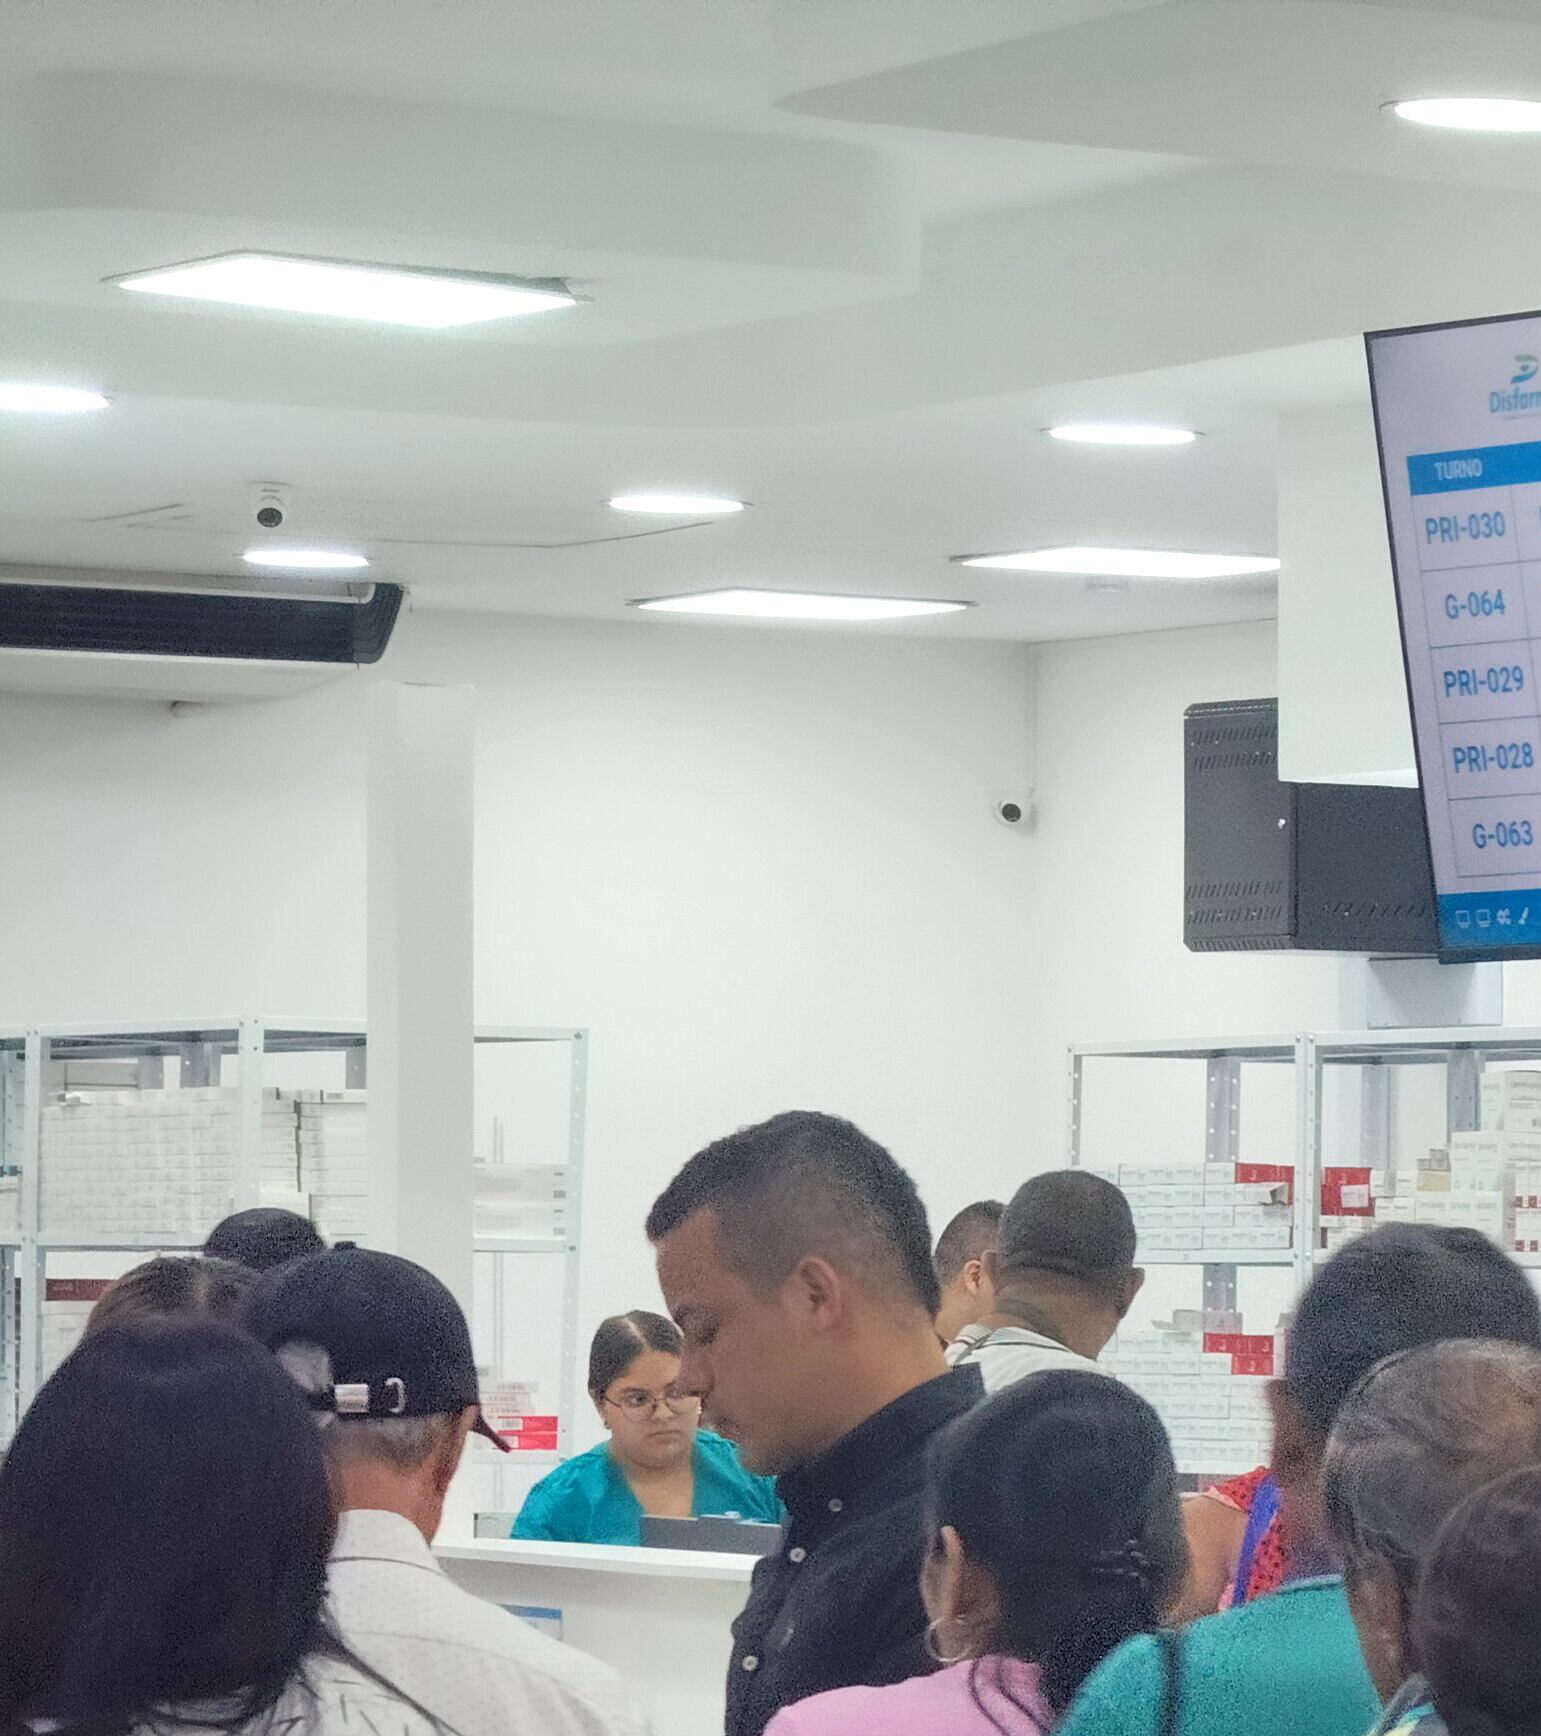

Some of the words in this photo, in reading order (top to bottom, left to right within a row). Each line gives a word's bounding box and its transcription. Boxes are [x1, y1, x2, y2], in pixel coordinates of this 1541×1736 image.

[1434, 459, 1482, 481] TURNO
[1425, 511, 1506, 545] PRI-030
[1445, 589, 1506, 620] G-064
[1443, 665, 1524, 697] PRI-029
[1453, 742, 1534, 774] PRI-028
[1472, 820, 1533, 849] G-063
